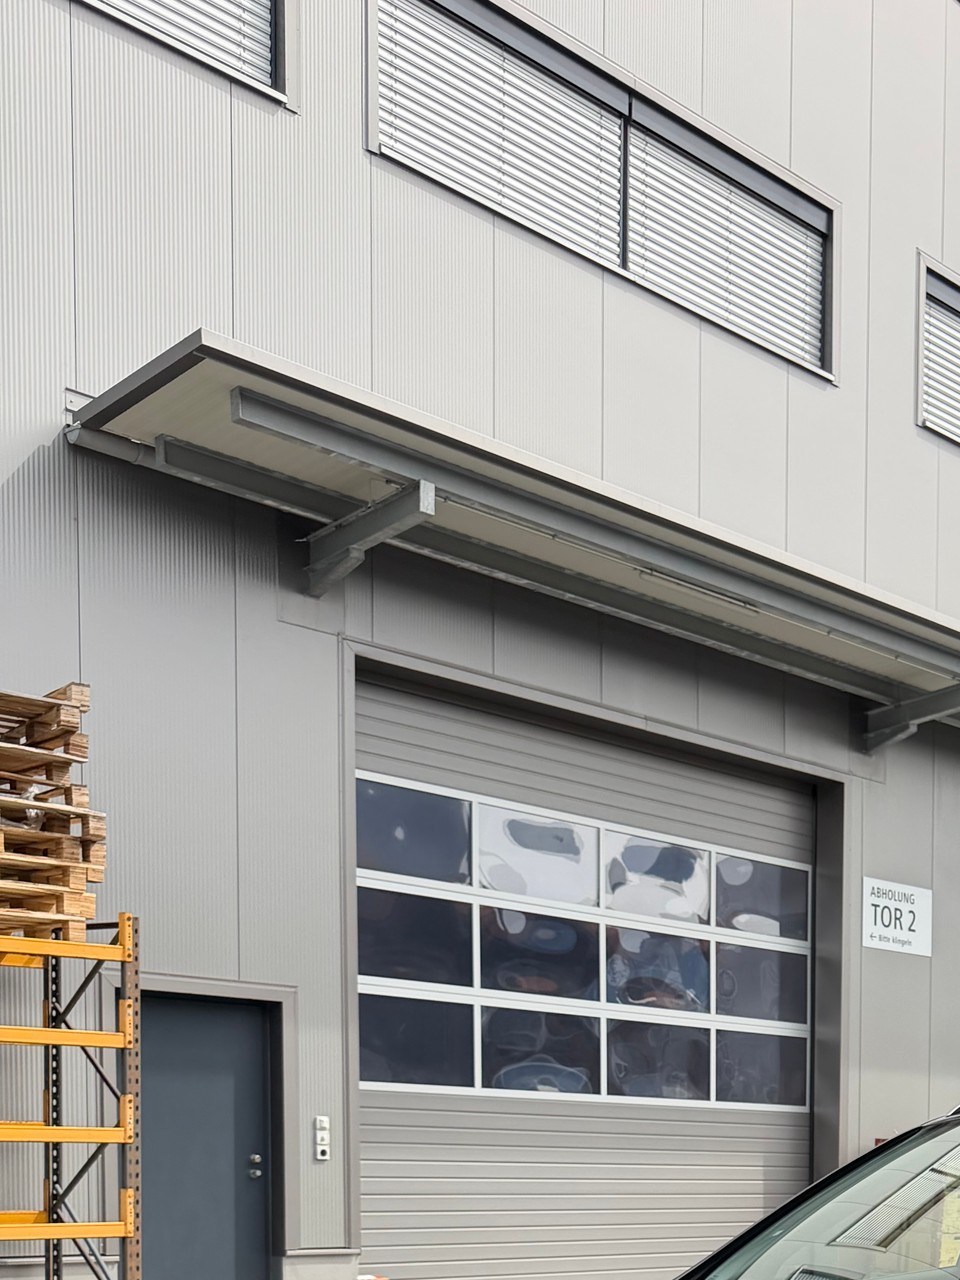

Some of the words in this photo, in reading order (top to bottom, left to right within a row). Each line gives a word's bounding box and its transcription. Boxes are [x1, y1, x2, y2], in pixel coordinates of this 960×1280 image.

[870, 886, 915, 905] ABHOLUNG
[871, 903, 903, 931] TOR
[908, 910, 916, 932] 2
